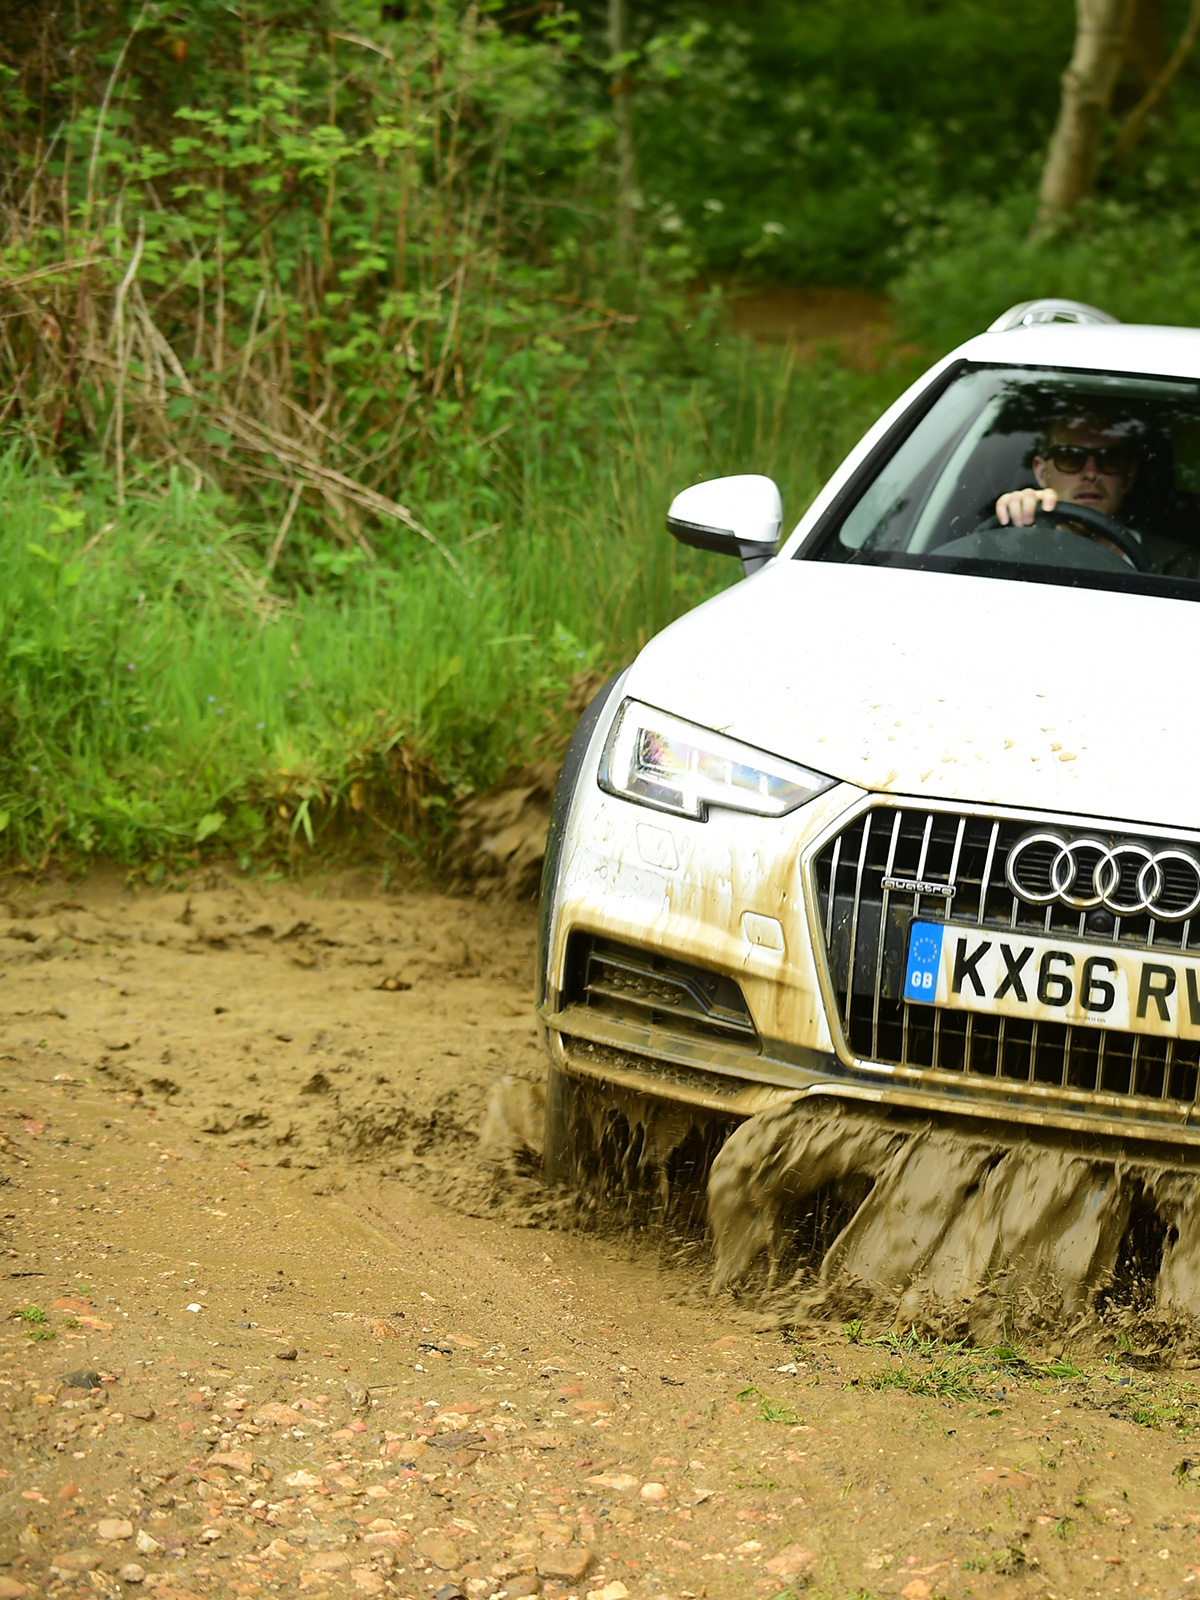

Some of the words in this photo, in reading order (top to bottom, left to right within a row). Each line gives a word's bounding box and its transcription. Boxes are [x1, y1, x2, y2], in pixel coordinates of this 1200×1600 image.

[884, 880, 952, 896] quattro
[911, 970, 933, 989] GB
[952, 937, 1118, 1013] KX66
